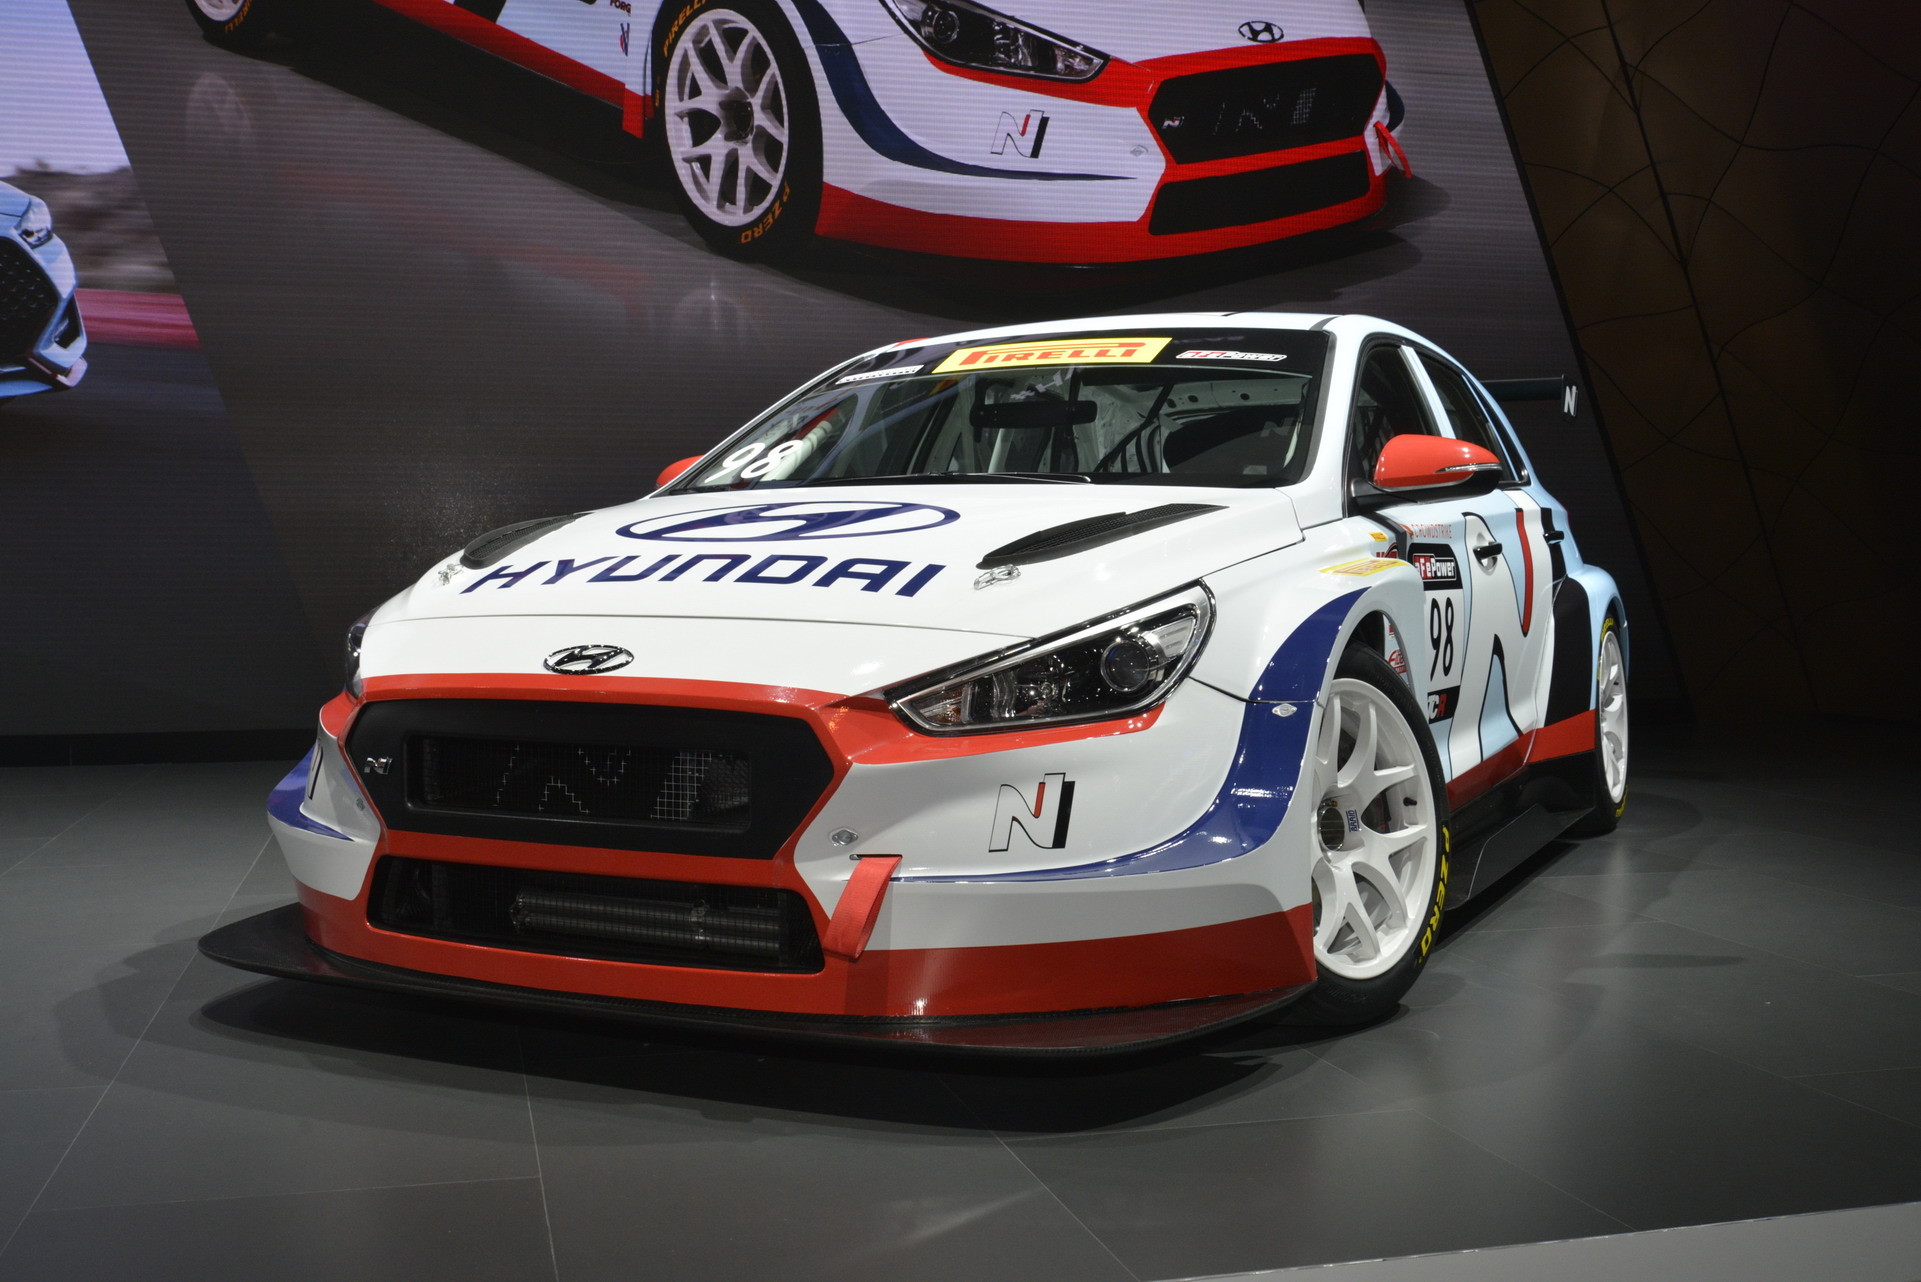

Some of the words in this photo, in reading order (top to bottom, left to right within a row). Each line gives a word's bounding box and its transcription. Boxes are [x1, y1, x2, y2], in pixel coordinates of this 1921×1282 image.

[960, 343, 1146, 366] PIRELLI
[1564, 385, 1578, 417] N
[704, 440, 803, 483] 98
[460, 554, 946, 597] HYUNDAI
[1430, 597, 1454, 682] 98
[989, 773, 1075, 852] N
[1347, 809, 1360, 833] BRAID
[1442, 825, 1450, 852] P
[1421, 855, 1449, 957] ZERO
